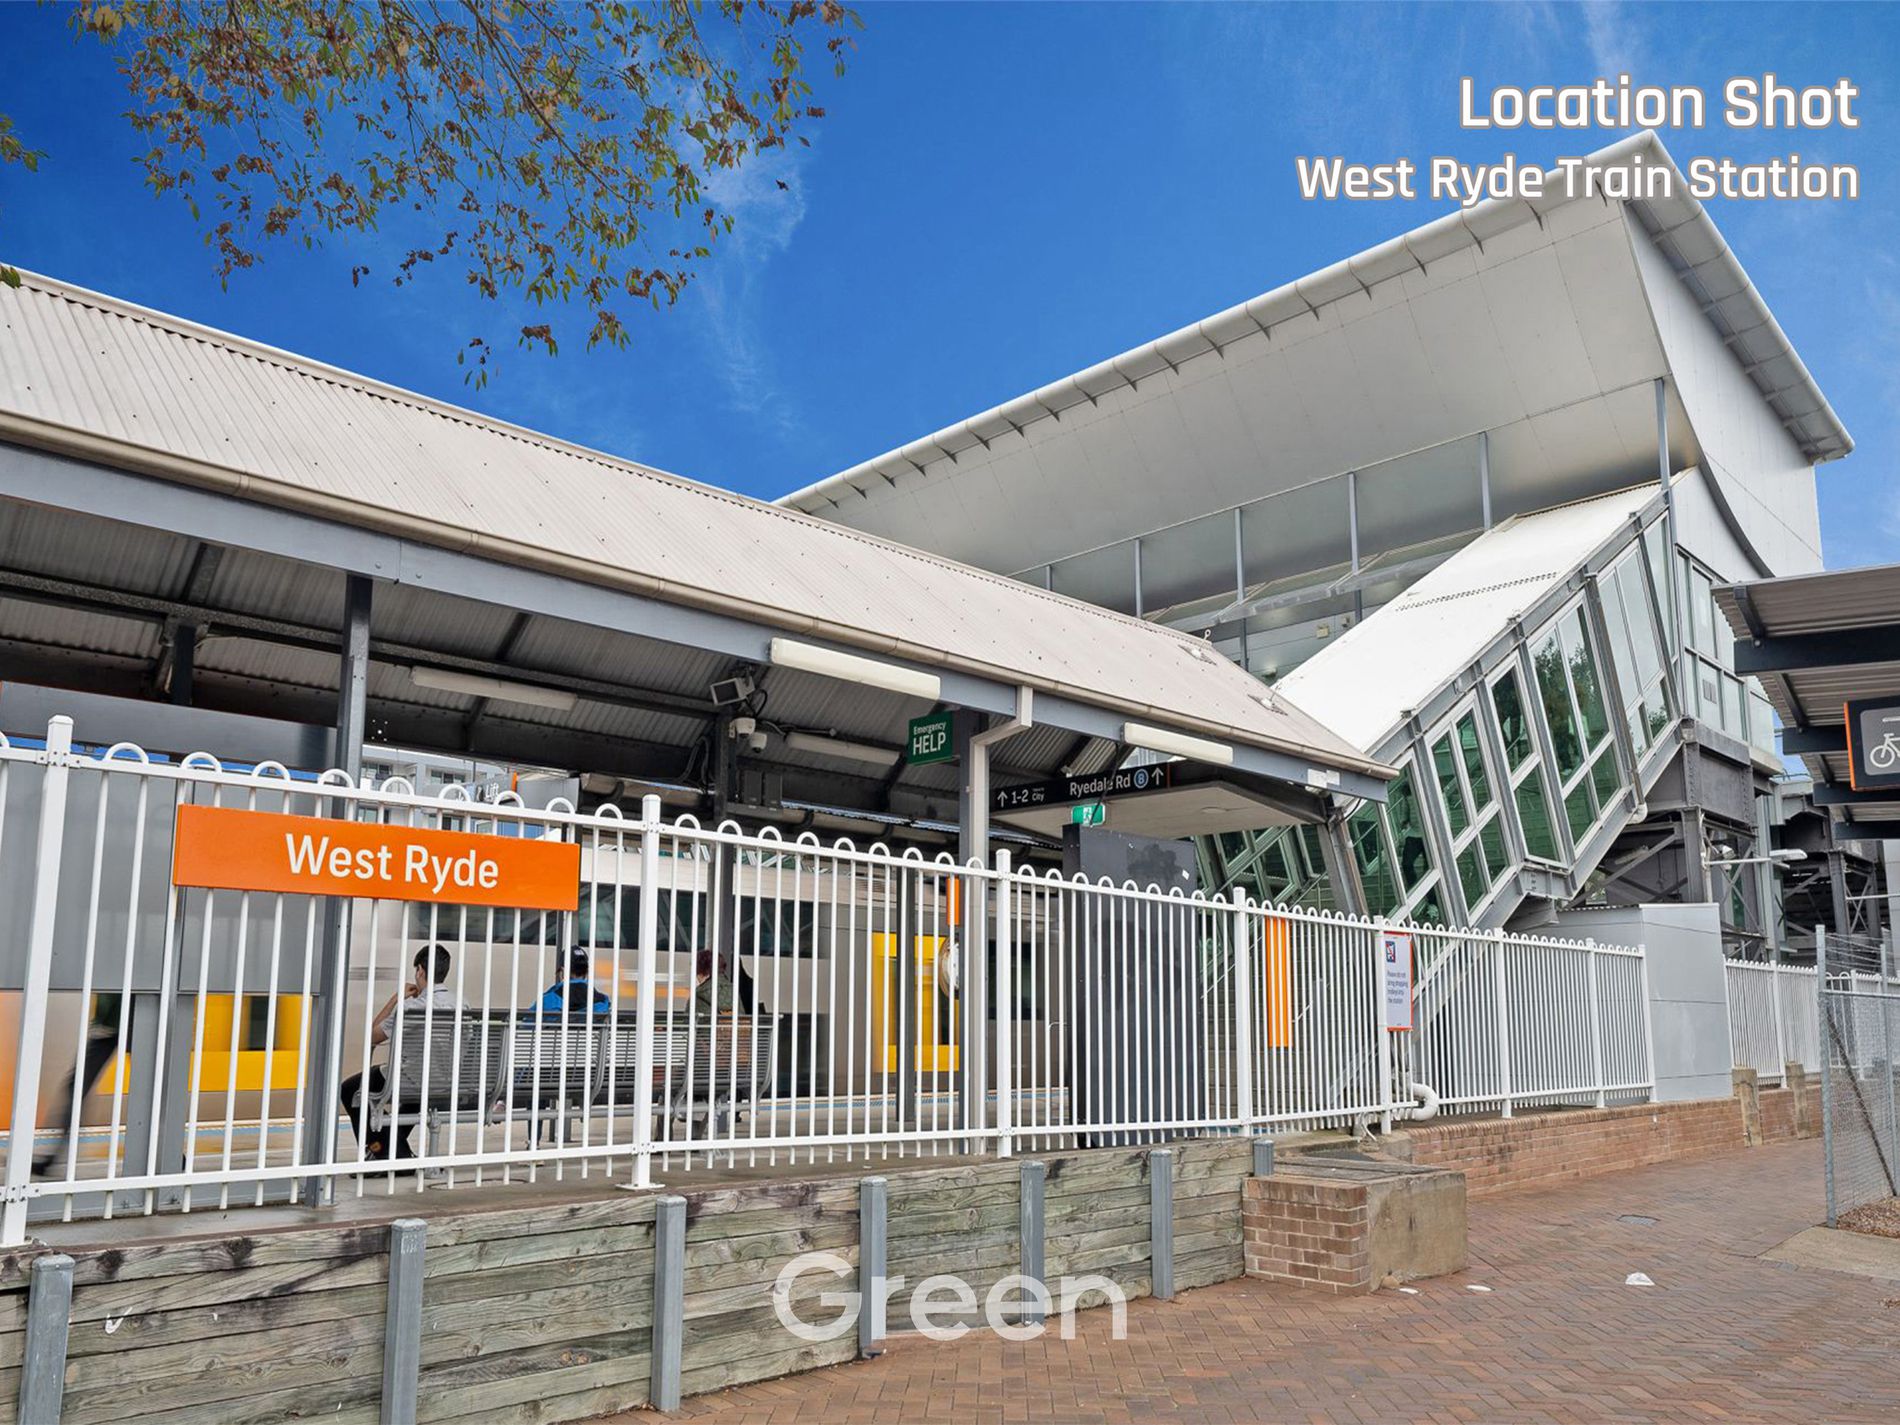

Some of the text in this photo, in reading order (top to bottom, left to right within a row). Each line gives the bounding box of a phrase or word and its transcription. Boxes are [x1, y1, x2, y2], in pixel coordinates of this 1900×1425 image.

[913, 720, 947, 735] Emergency
[912, 731, 946, 756] HELP
[1011, 789, 1029, 804] 1-2
[1069, 777, 1113, 798] Ryedale
[1115, 773, 1131, 789] Rd
[285, 832, 499, 895] West Ryde
